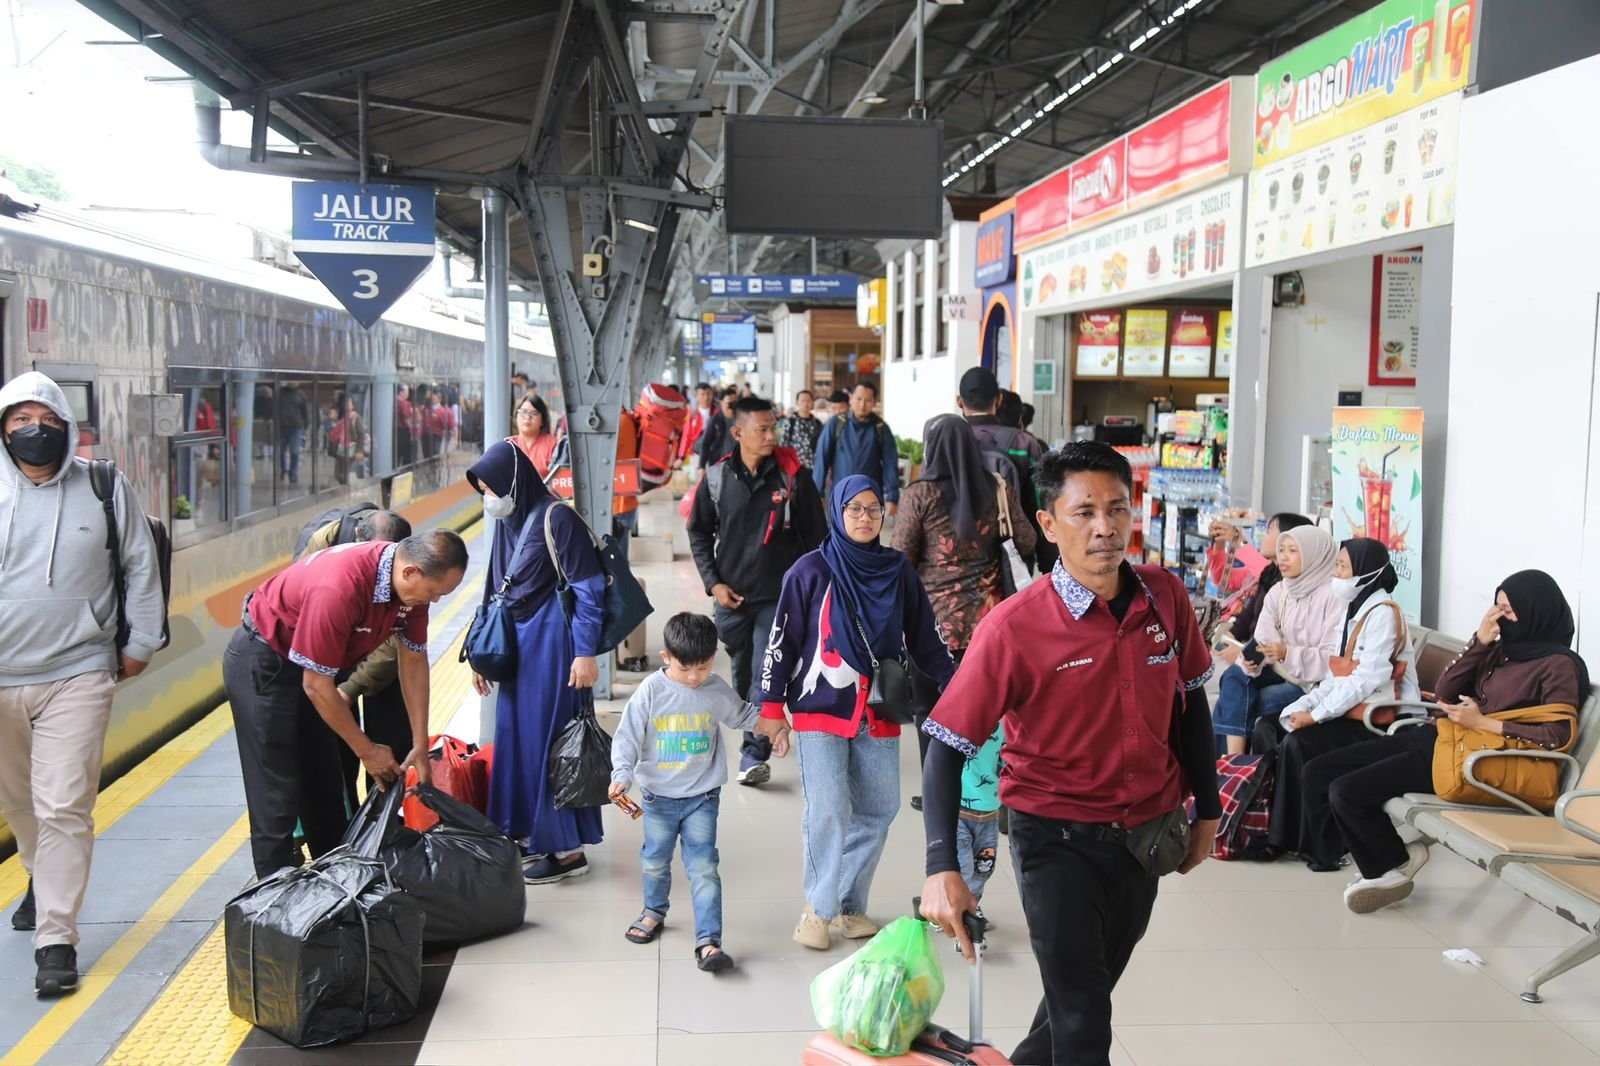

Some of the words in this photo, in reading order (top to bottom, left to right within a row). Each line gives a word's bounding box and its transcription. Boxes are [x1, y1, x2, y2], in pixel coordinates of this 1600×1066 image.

[313, 193, 415, 222] JALUR
[1200, 191, 1231, 217] CHOCOLATE
[332, 222, 391, 241] TRACK
[351, 268, 380, 300] 3
[1338, 424, 1379, 445] Daftar
[1383, 425, 1419, 442] Menu
